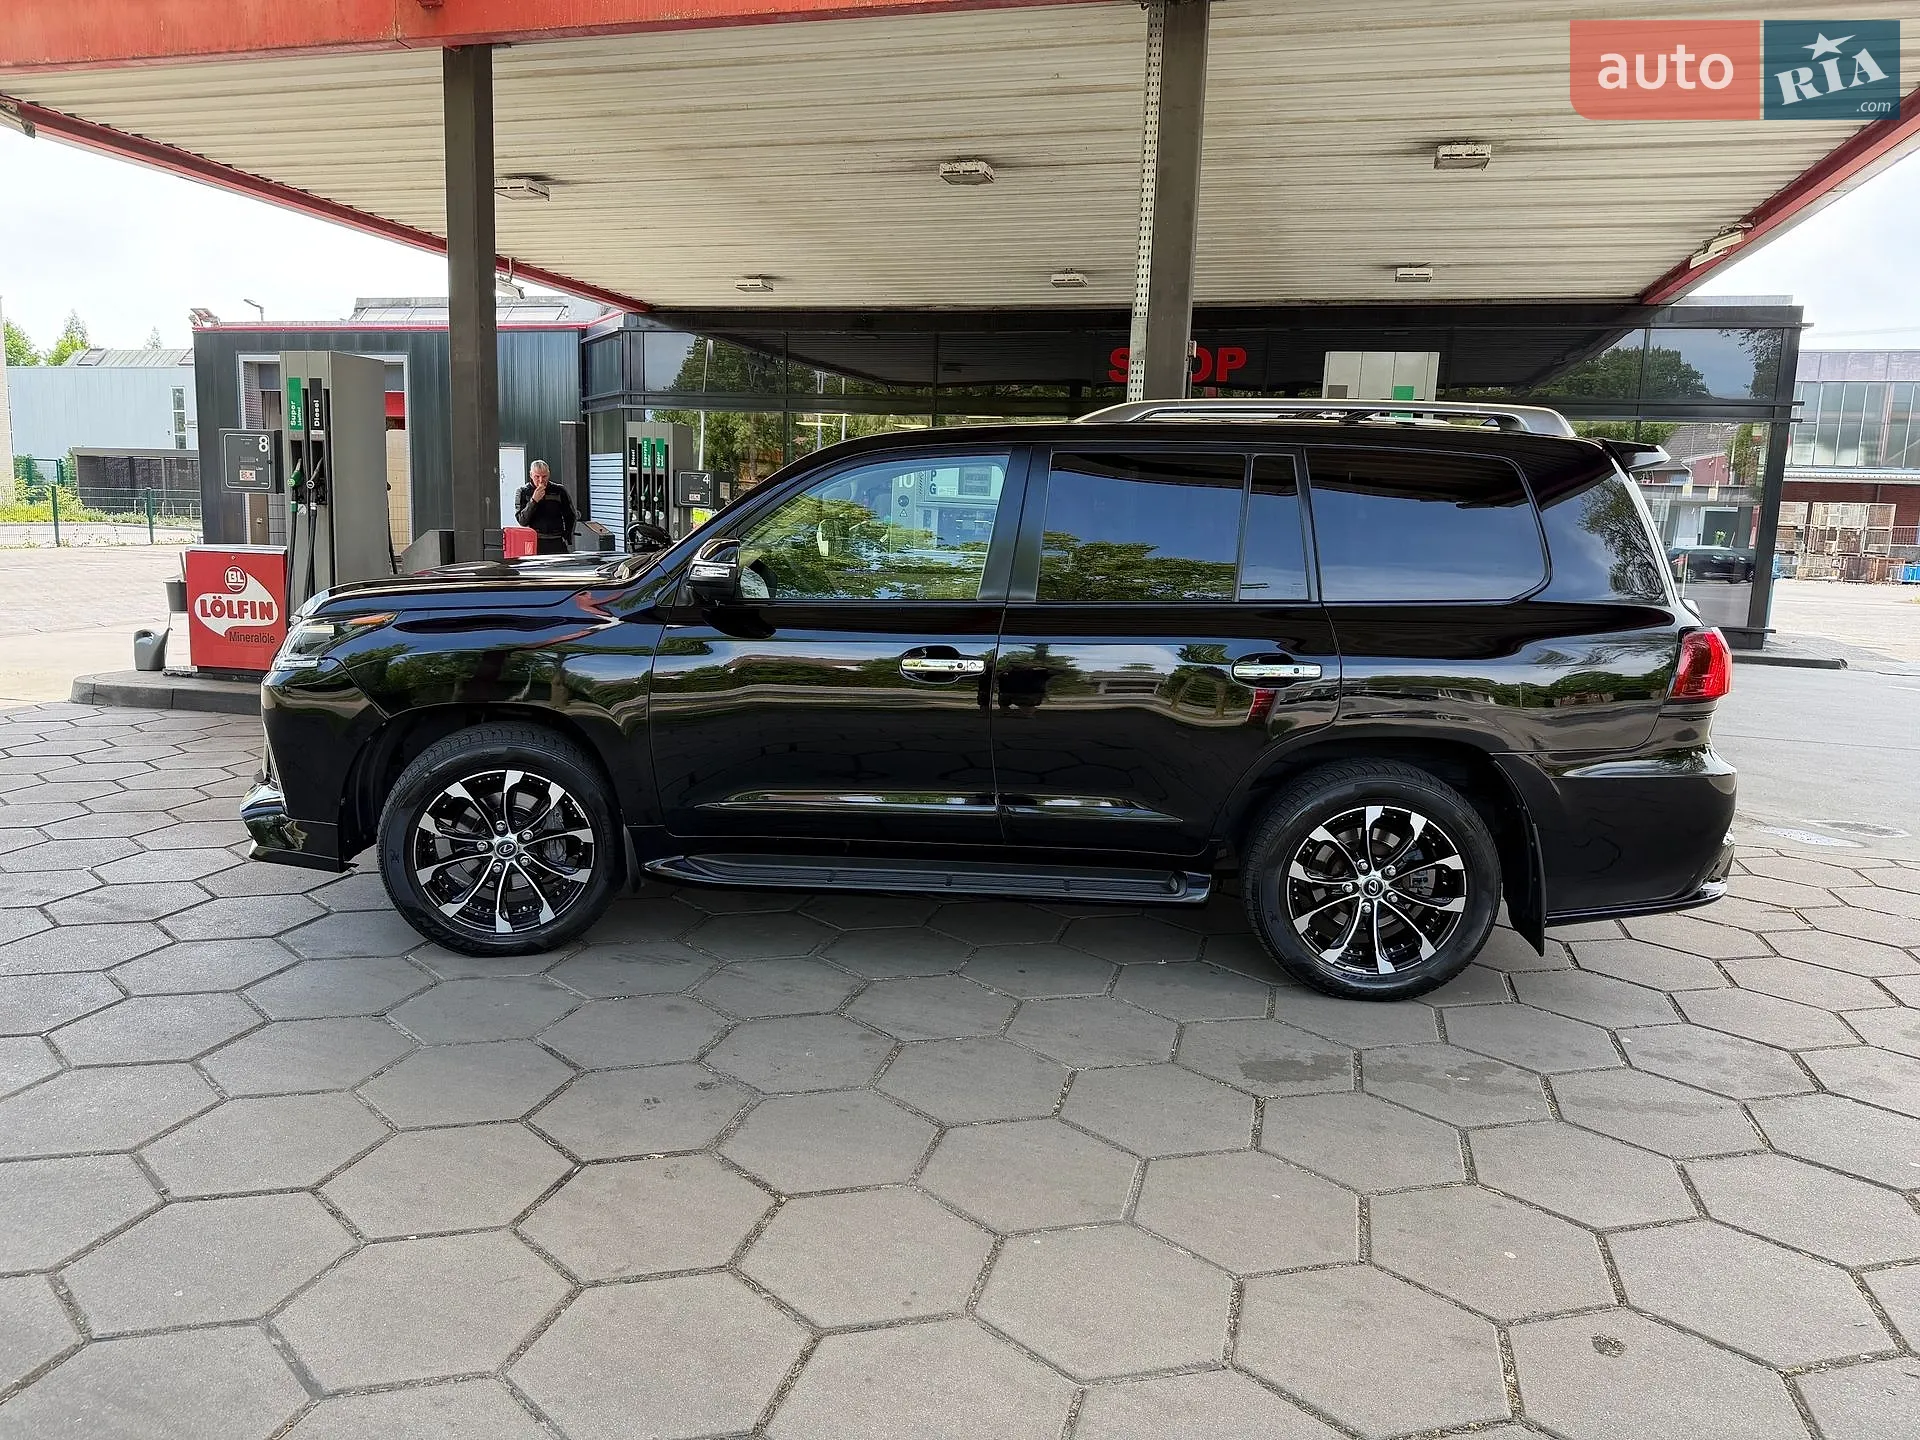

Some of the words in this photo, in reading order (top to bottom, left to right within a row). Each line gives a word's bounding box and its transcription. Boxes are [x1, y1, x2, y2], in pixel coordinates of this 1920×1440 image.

[1108, 346, 1247, 383] SOP
[313, 399, 321, 427] Diesel
[258, 436, 269, 453] 8
[702, 473, 711, 485] 4
[227, 571, 245, 583] BL
[199, 595, 274, 621] LÖLFIN
[229, 631, 276, 644] Mineralöle
